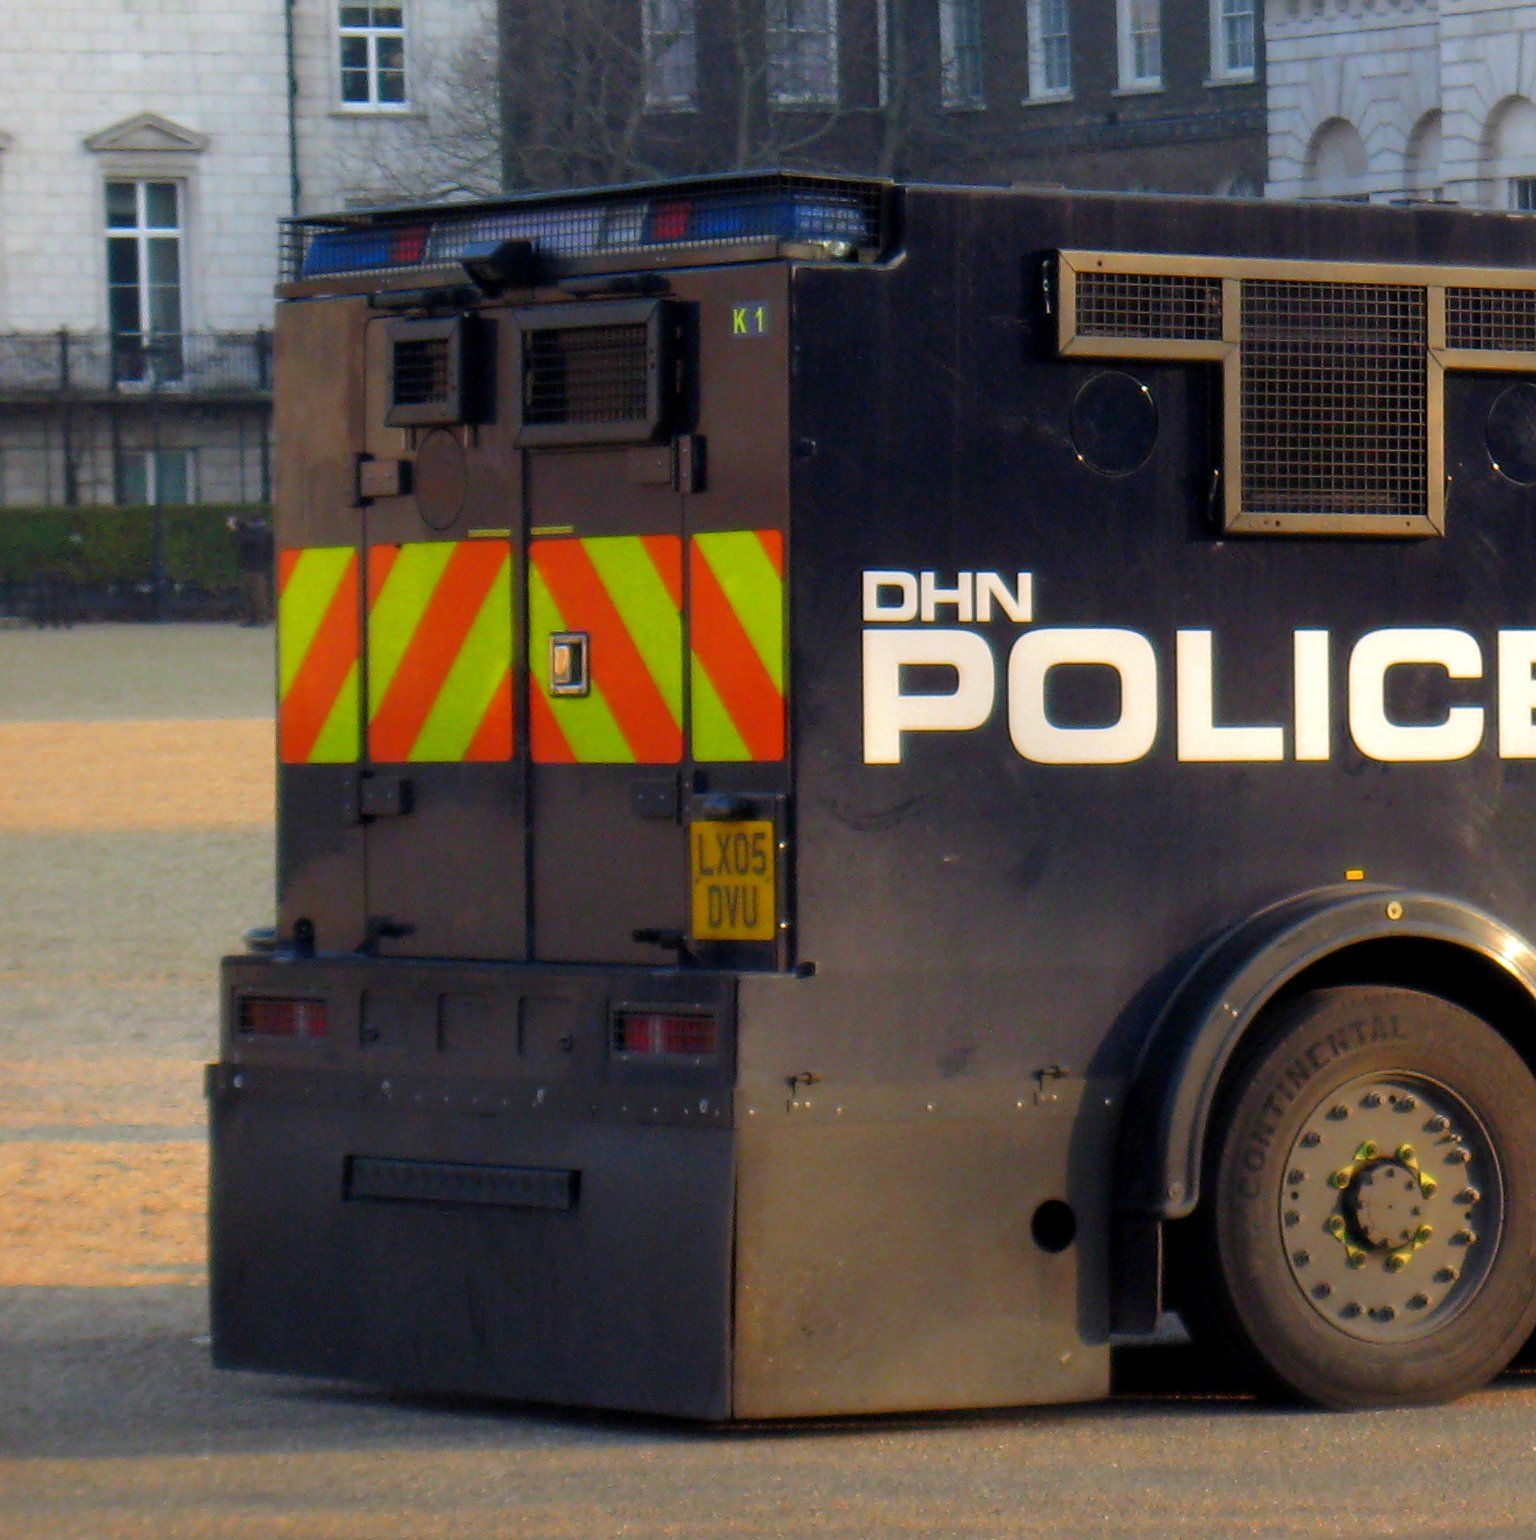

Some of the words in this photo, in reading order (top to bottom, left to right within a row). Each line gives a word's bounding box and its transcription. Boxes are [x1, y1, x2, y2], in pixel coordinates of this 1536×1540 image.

[732, 308, 748, 334] K
[754, 306, 765, 332] 1
[862, 571, 1033, 622] DHN
[698, 832, 766, 876] LX05
[708, 884, 758, 928] DVU
[1240, 1013, 1406, 1200] CONTINENTAL
